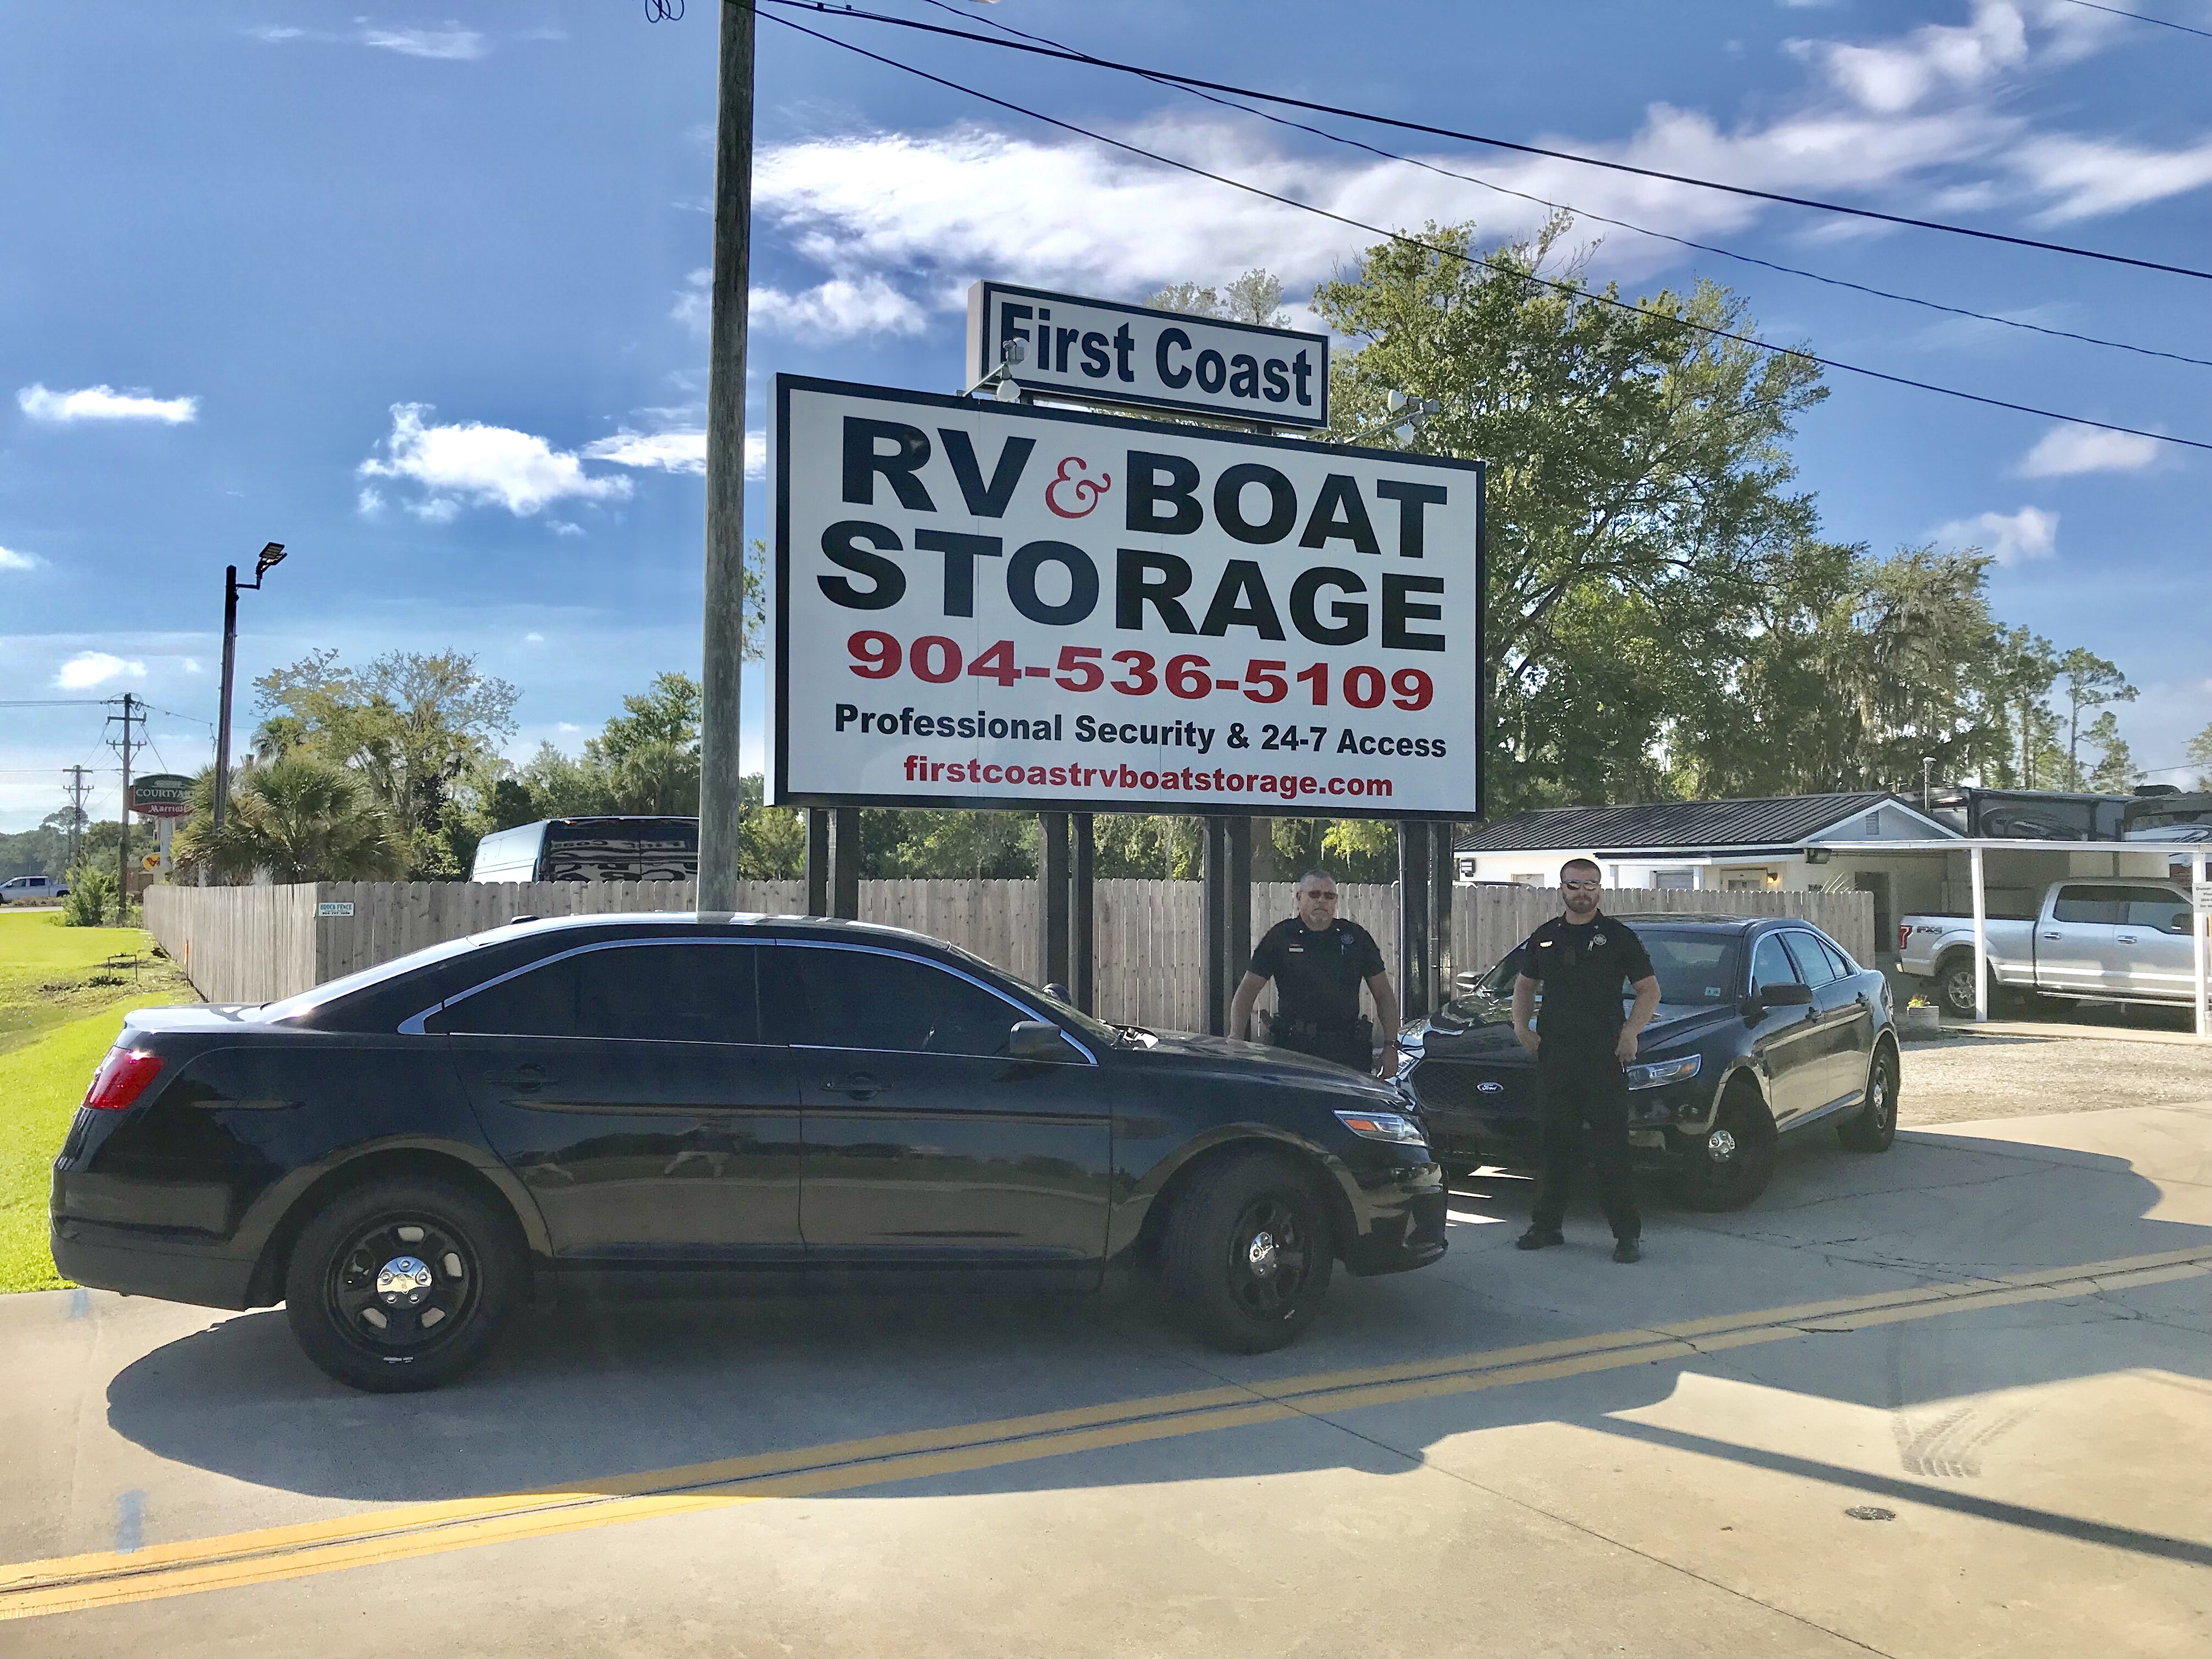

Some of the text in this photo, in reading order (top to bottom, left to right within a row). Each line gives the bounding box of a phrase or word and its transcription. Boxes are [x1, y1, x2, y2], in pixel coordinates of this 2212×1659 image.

[1001, 301, 1312, 407] First Coast
[842, 415, 1448, 559] RV & BOAT
[816, 520, 1446, 652] STORAGE
[847, 630, 1434, 711] 904-536-5109
[835, 703, 1447, 758] Professional Security & 24-7 Access
[136, 788, 194, 798] COURTYAR
[904, 755, 1393, 799] firstcoastrvboatstorage.com
[1916, 926, 1943, 934] FX4
